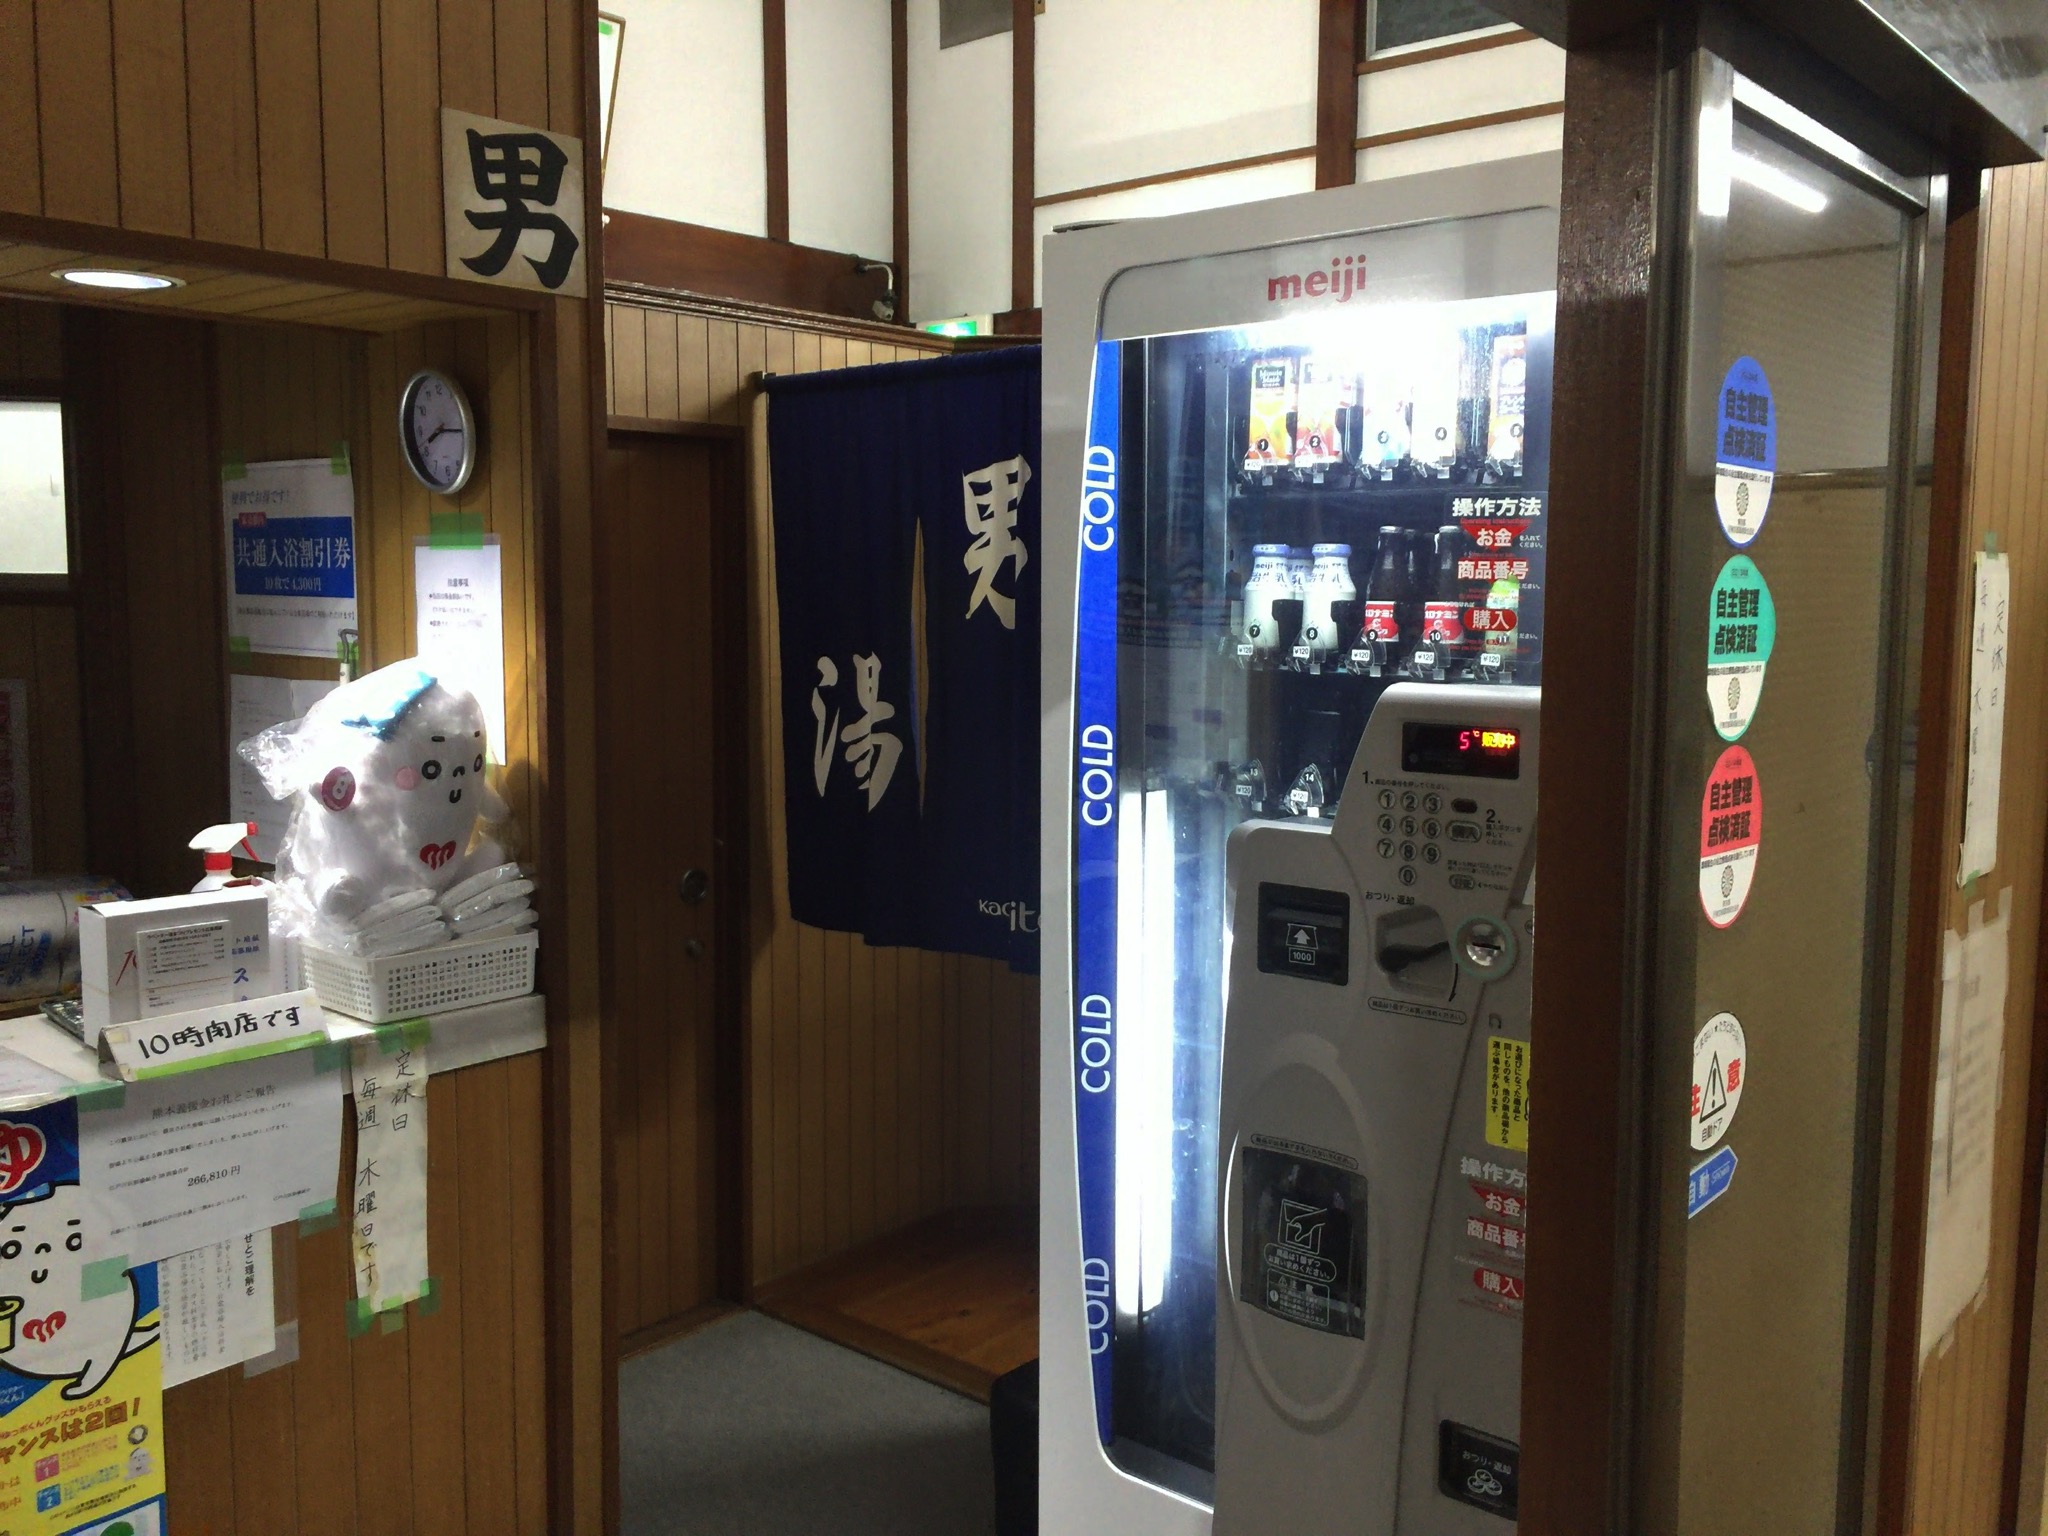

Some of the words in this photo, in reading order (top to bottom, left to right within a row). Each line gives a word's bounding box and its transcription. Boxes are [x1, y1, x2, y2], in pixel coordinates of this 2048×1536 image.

[460, 128, 579, 289] 男
[1268, 254, 1366, 303] meiji
[1725, 387, 1769, 426] 自主管理
[1723, 424, 1767, 462] 点検済証
[1083, 446, 1115, 551] COLD
[1452, 497, 1542, 517] 操作方法
[236, 537, 351, 569] 共通入浴割引券
[962, 454, 1031, 629] 男
[1476, 528, 1512, 547] お金
[1457, 560, 1529, 580] 商品番号
[1472, 610, 1510, 629] 購入
[1716, 587, 1760, 619] 自主管理
[1294, 646, 1309, 655] ¥120
[1353, 651, 1369, 660] ¥120
[1714, 624, 1758, 655] 点検済証
[1417, 653, 1434, 663] ¥120
[1482, 655, 1500, 664] ¥120
[812, 651, 903, 814] 湯
[1459, 731, 1470, 750] 5
[1082, 724, 1113, 826] COLD
[1710, 776, 1753, 811] 自主管理
[1486, 809, 1501, 824] 2.
[1707, 811, 1751, 847] 点検済証
[1292, 951, 1312, 962] 1000
[138, 1006, 300, 1059] 10時閉店です
[1081, 994, 1112, 1093] COLD
[391, 1049, 416, 1131] 定休日
[1490, 1040, 1500, 1118] 選ぶ場合があります。
[1513, 1044, 1524, 1123] お選びになった商品と
[1727, 1057, 1741, 1094] 意
[358, 1078, 383, 1131] 毎週
[1702, 1117, 1724, 1144] 自動ドア
[1460, 1156, 1527, 1188] 操作方
[357, 1158, 381, 1287] 木曜日です
[1485, 1193, 1521, 1217] お金
[244, 1233, 255, 1297] せとご理解を
[1482, 1270, 1520, 1298] 購入
[1084, 1258, 1110, 1354] COLD
